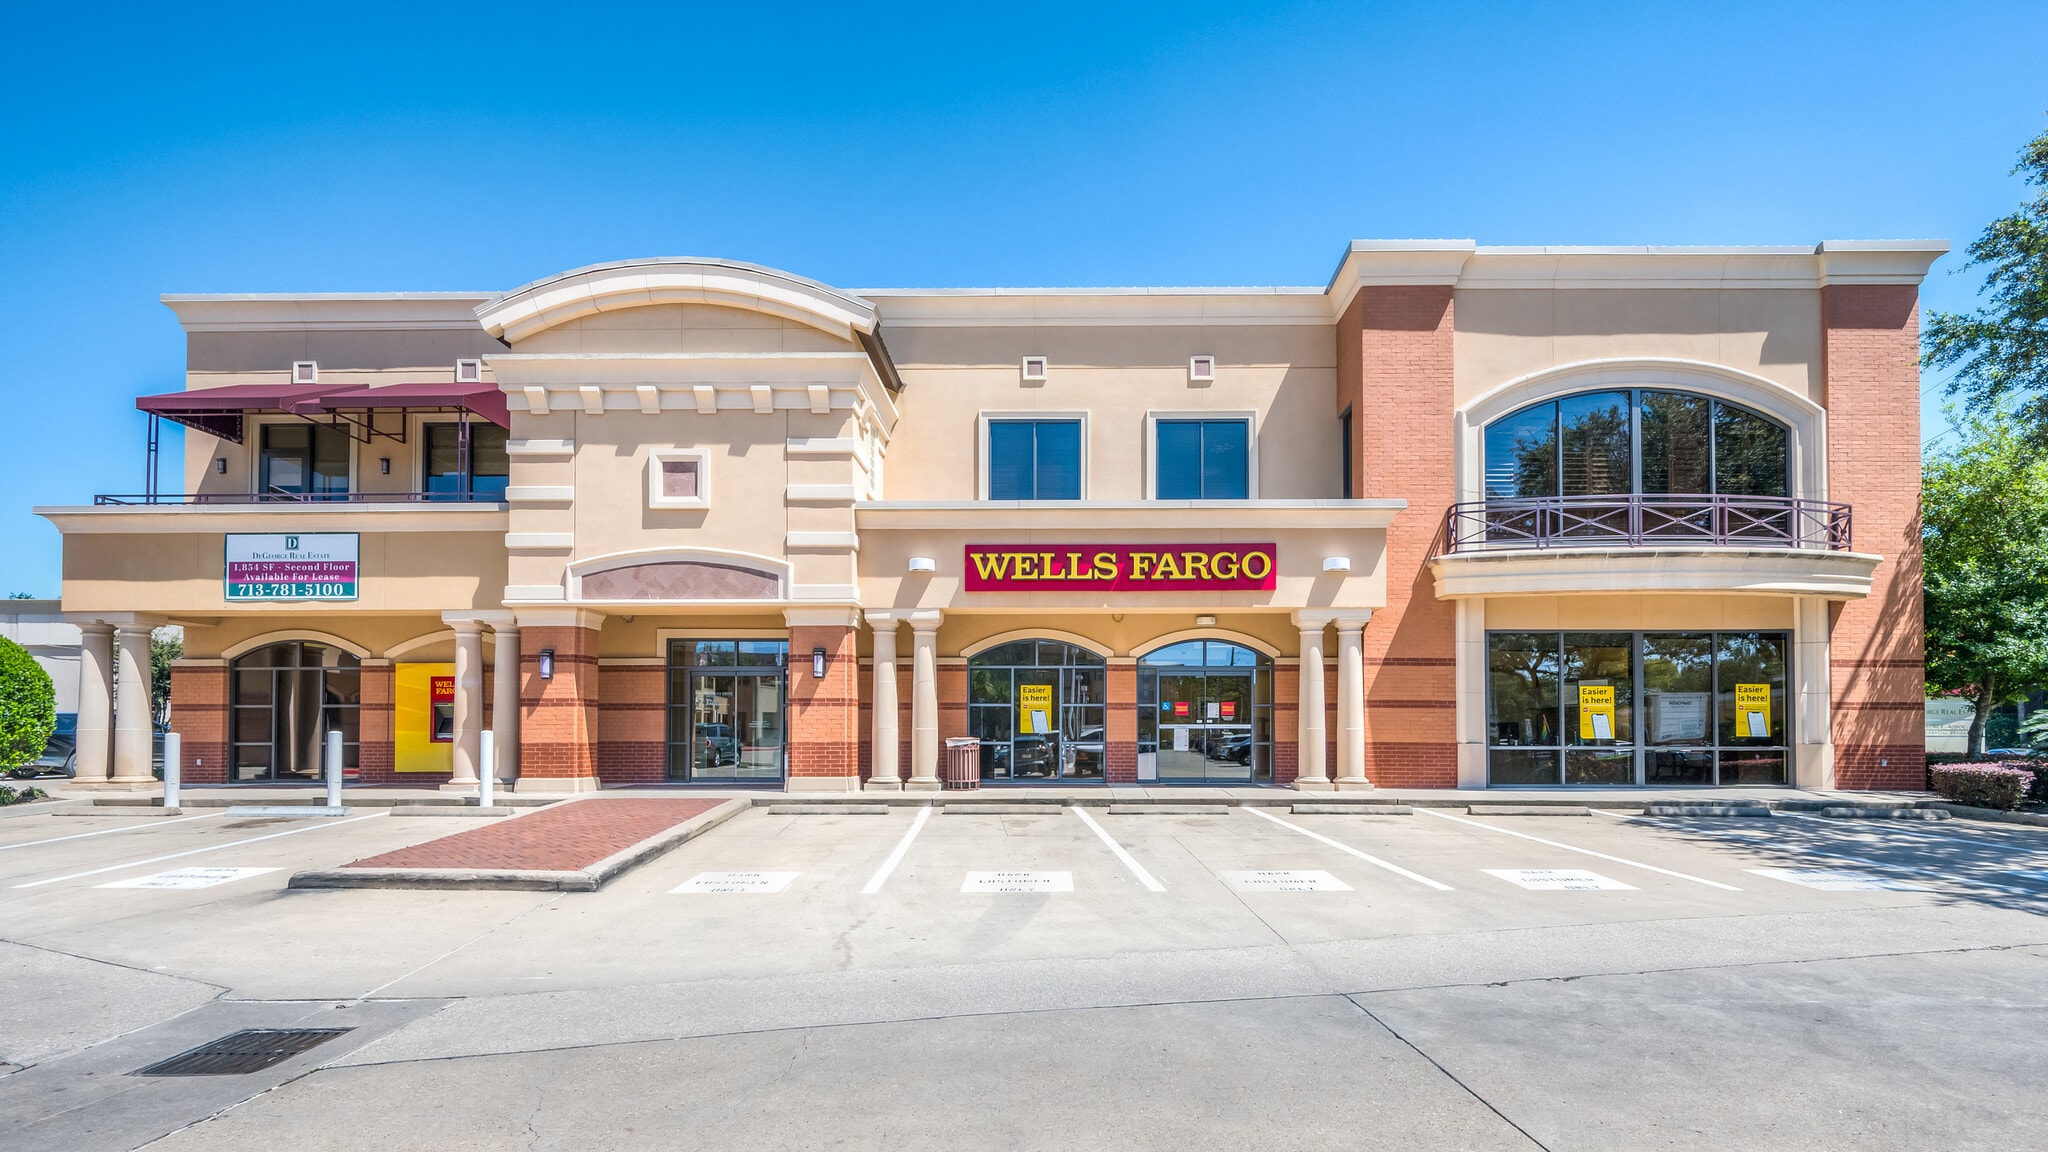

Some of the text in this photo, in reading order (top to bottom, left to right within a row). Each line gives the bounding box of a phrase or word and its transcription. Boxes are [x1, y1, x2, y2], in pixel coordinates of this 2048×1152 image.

[233, 563, 259, 572] 1,854
[262, 563, 275, 571] SF
[285, 563, 320, 571] Second
[323, 563, 350, 571] Floor
[969, 550, 1273, 581] WELLS FARGO
[243, 573, 340, 581] Available For Lease
[238, 583, 344, 597] 713-781-5100
[435, 680, 455, 688] WEL
[1022, 686, 1046, 694] Easier
[1582, 687, 1608, 695] Easier
[1738, 685, 1764, 693] Easier
[1022, 694, 1050, 702] is here!
[1582, 696, 1612, 704] is here!
[1738, 694, 1768, 702] is here!
